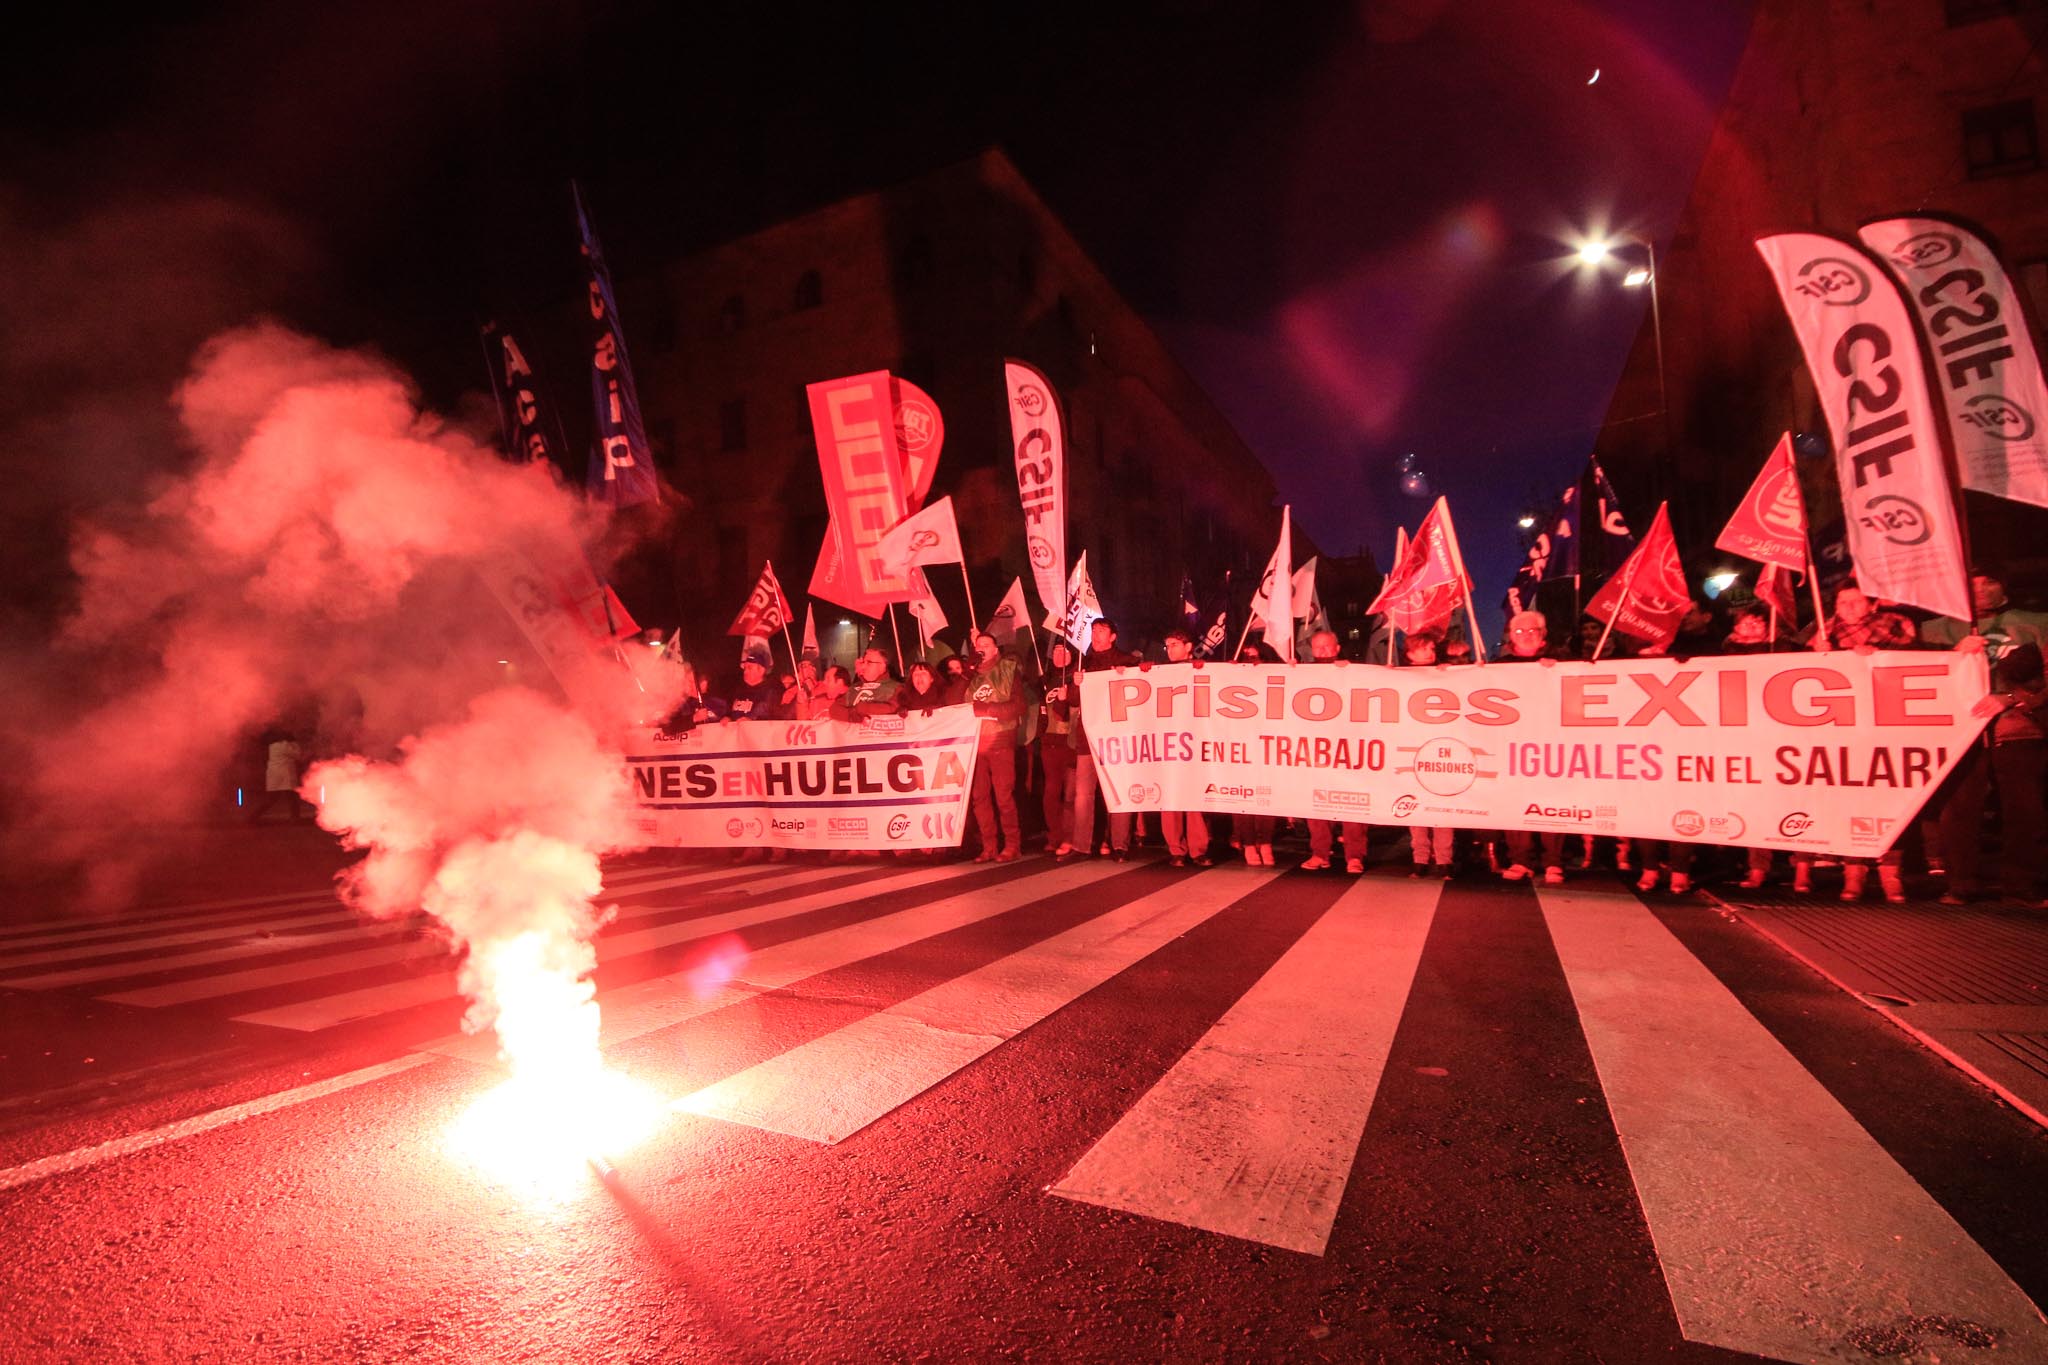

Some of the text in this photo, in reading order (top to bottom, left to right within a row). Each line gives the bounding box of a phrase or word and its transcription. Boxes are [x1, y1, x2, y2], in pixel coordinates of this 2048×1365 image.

[1108, 675, 1521, 726] Prisiones
[1560, 664, 1954, 727] EXIGE
[1098, 731, 1386, 771] IGUALES EN EL TRABAJO
[1439, 747, 1452, 759] EN
[1417, 761, 1474, 775] PRISIONES
[1508, 742, 1664, 782] IGUALES
[1677, 755, 1716, 784] EN
[1726, 755, 1762, 785] EL
[722, 771, 764, 797] EN
[763, 751, 967, 797] HUELGA
[1204, 783, 1254, 799] Acaip
[1523, 803, 1593, 822] Acaip
[771, 818, 805, 832] Acaip
[1785, 818, 1815, 830] CSIF
